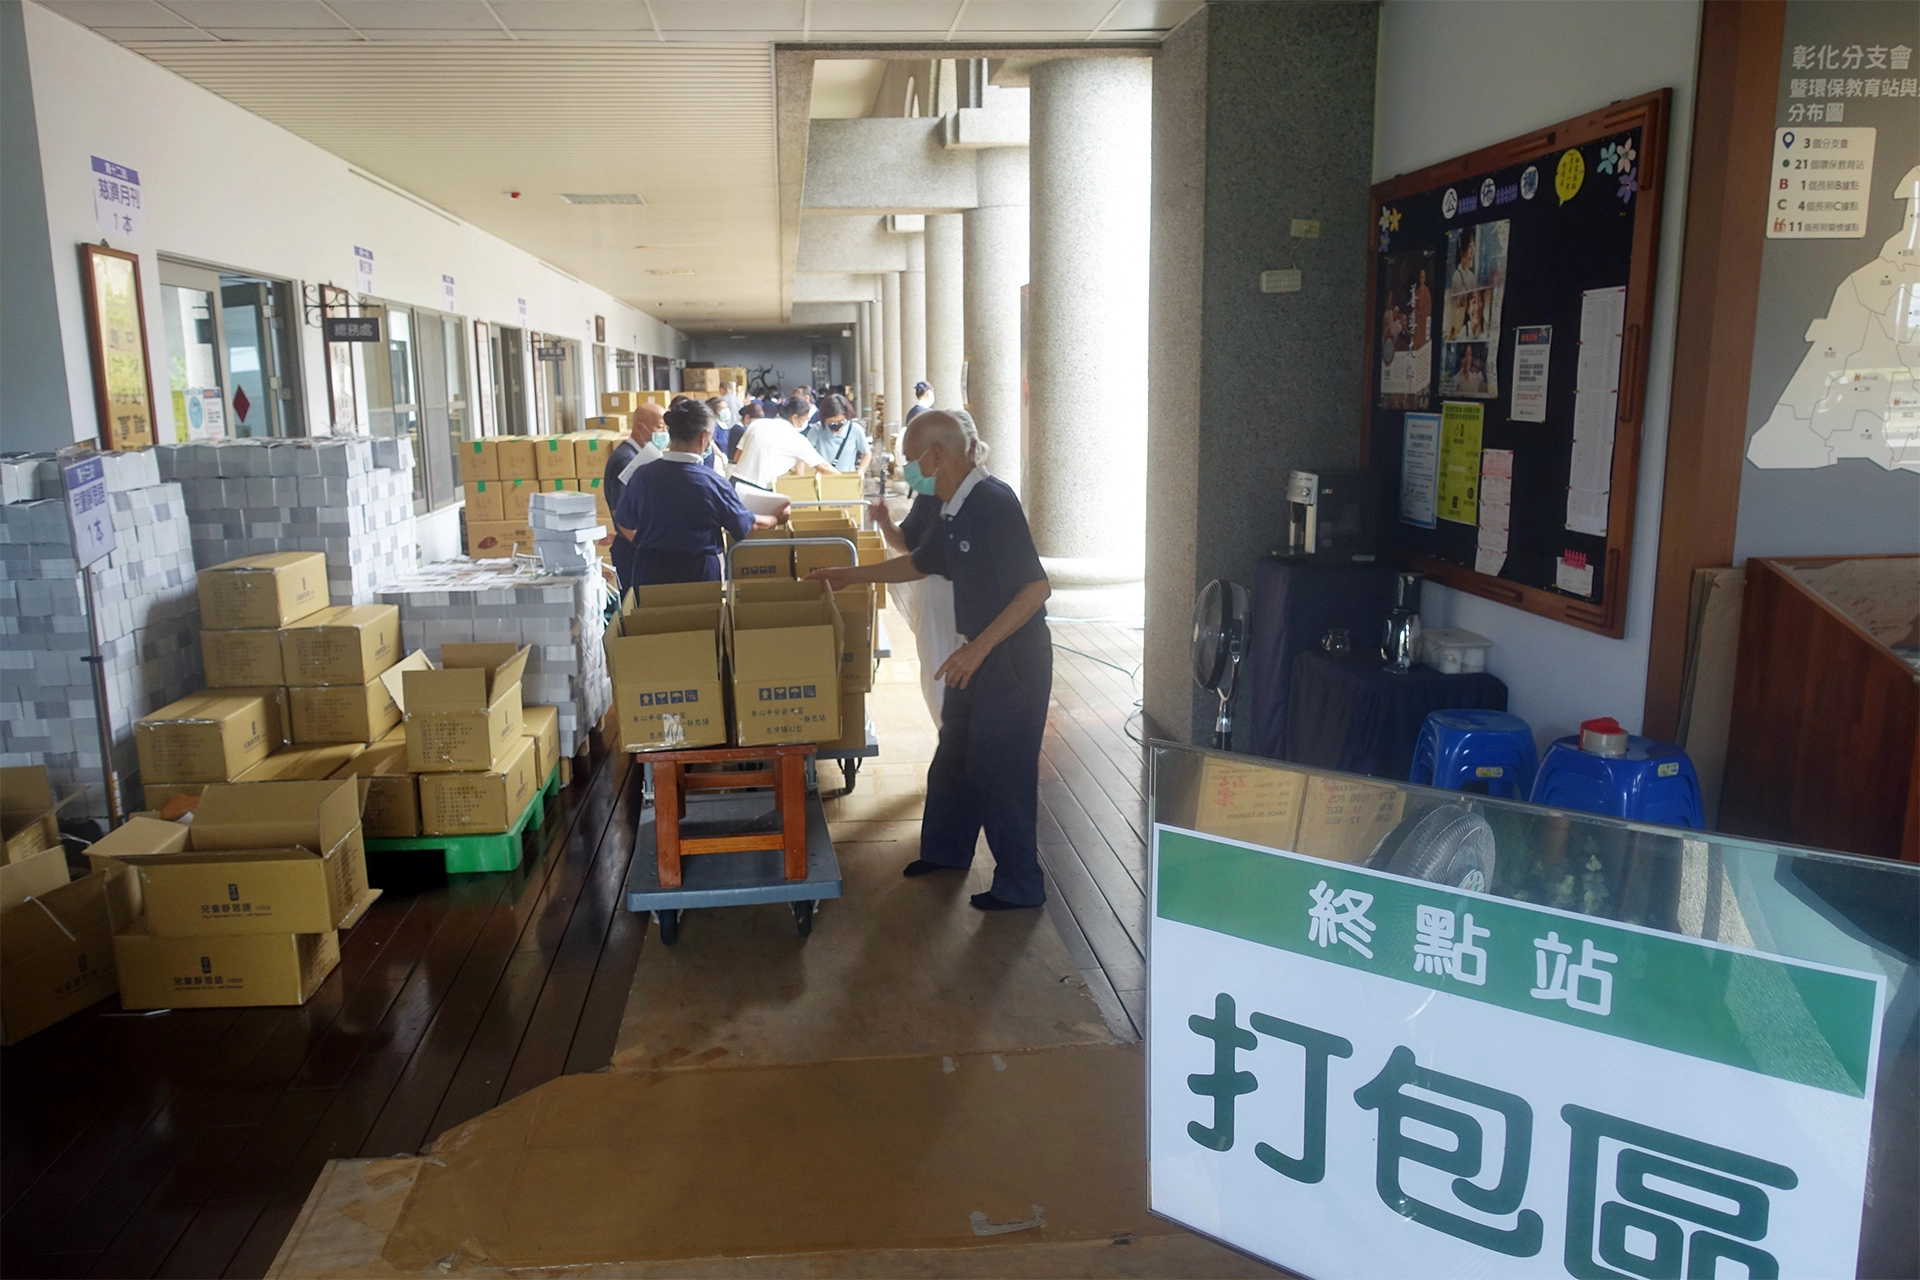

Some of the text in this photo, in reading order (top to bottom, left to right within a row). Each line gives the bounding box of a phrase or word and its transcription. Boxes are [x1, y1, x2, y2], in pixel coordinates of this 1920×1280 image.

[1792, 45, 1913, 70] 彰化分支會
[1789, 78, 1920, 98] 暨環保教育站與
[1788, 102, 1844, 122] 分布圖
[98, 178, 140, 209] 慈濟月刊
[1308, 879, 1619, 1016] 終點站
[1186, 992, 1799, 1280] 打包區
